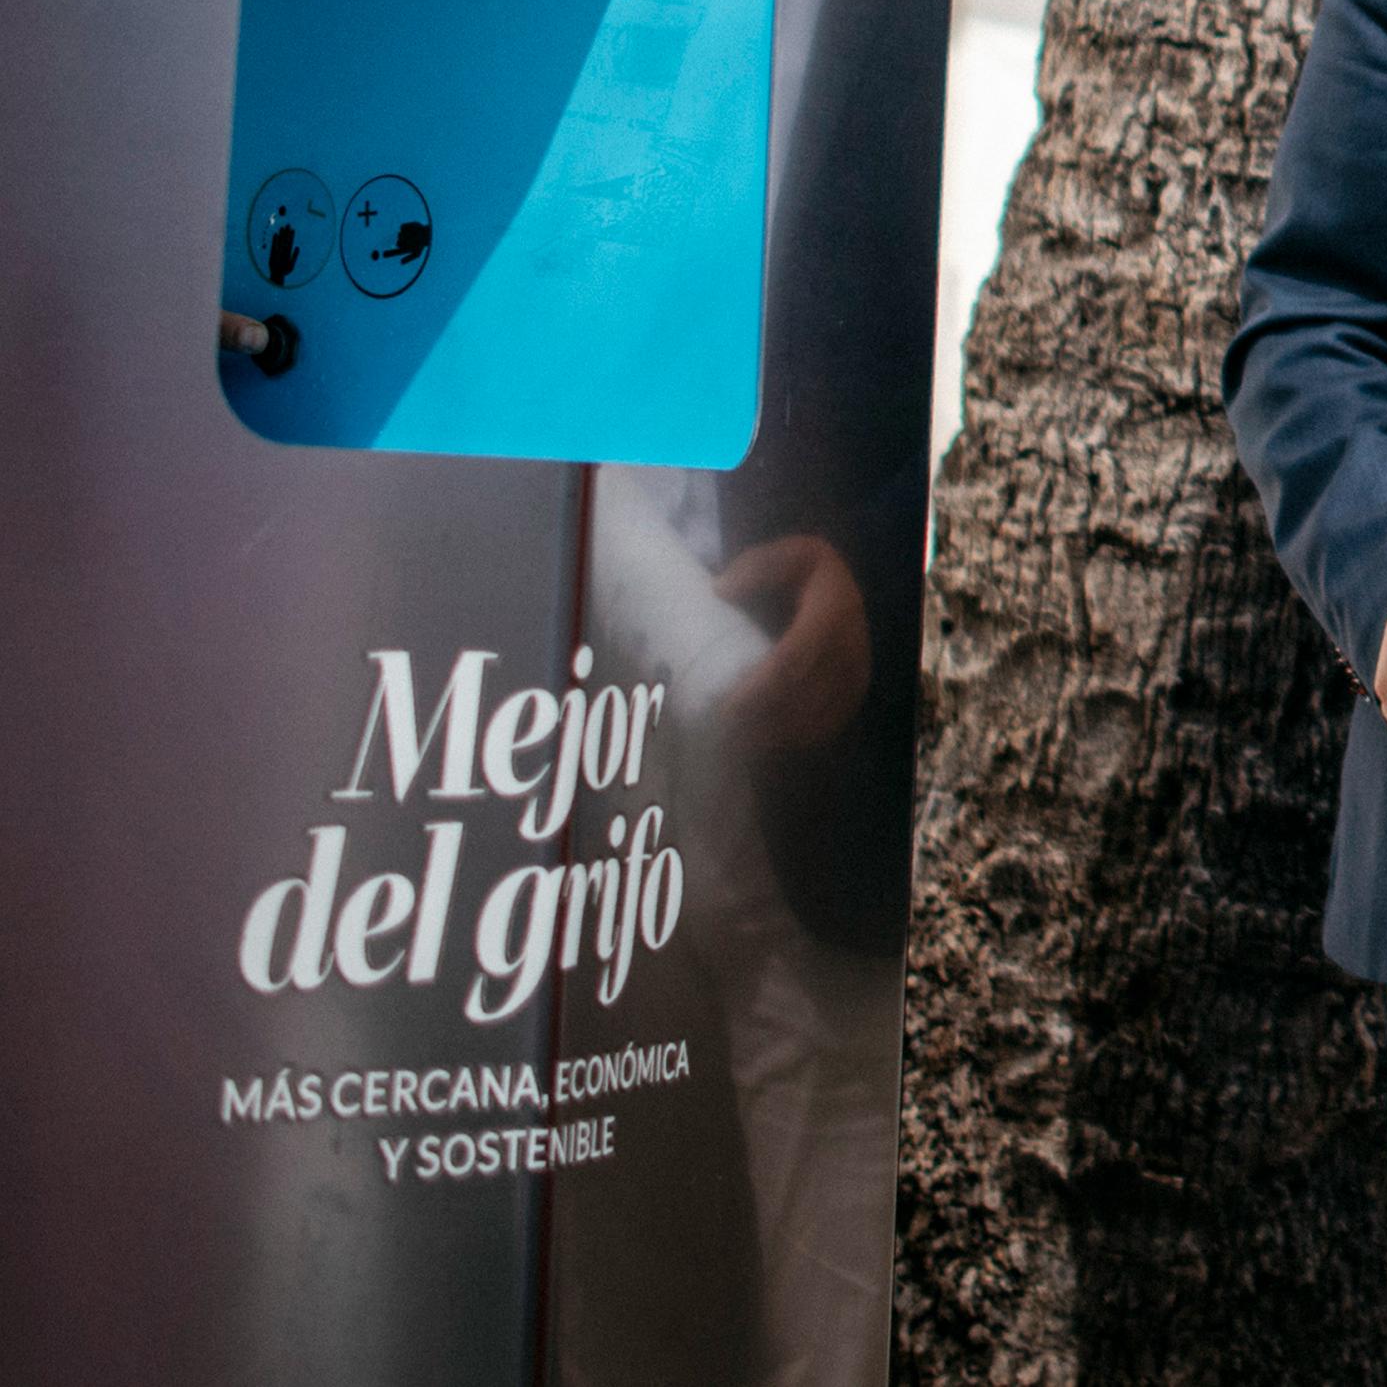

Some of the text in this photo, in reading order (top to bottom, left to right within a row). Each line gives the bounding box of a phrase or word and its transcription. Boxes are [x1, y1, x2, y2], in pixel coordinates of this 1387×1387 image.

[331, 645, 664, 841] Mejor
[238, 804, 683, 1024] del grifo
[222, 1038, 690, 1123] MÁS CERCANA, ECONÓMICA
[379, 1115, 616, 1180] Y SOSTENIBLE
